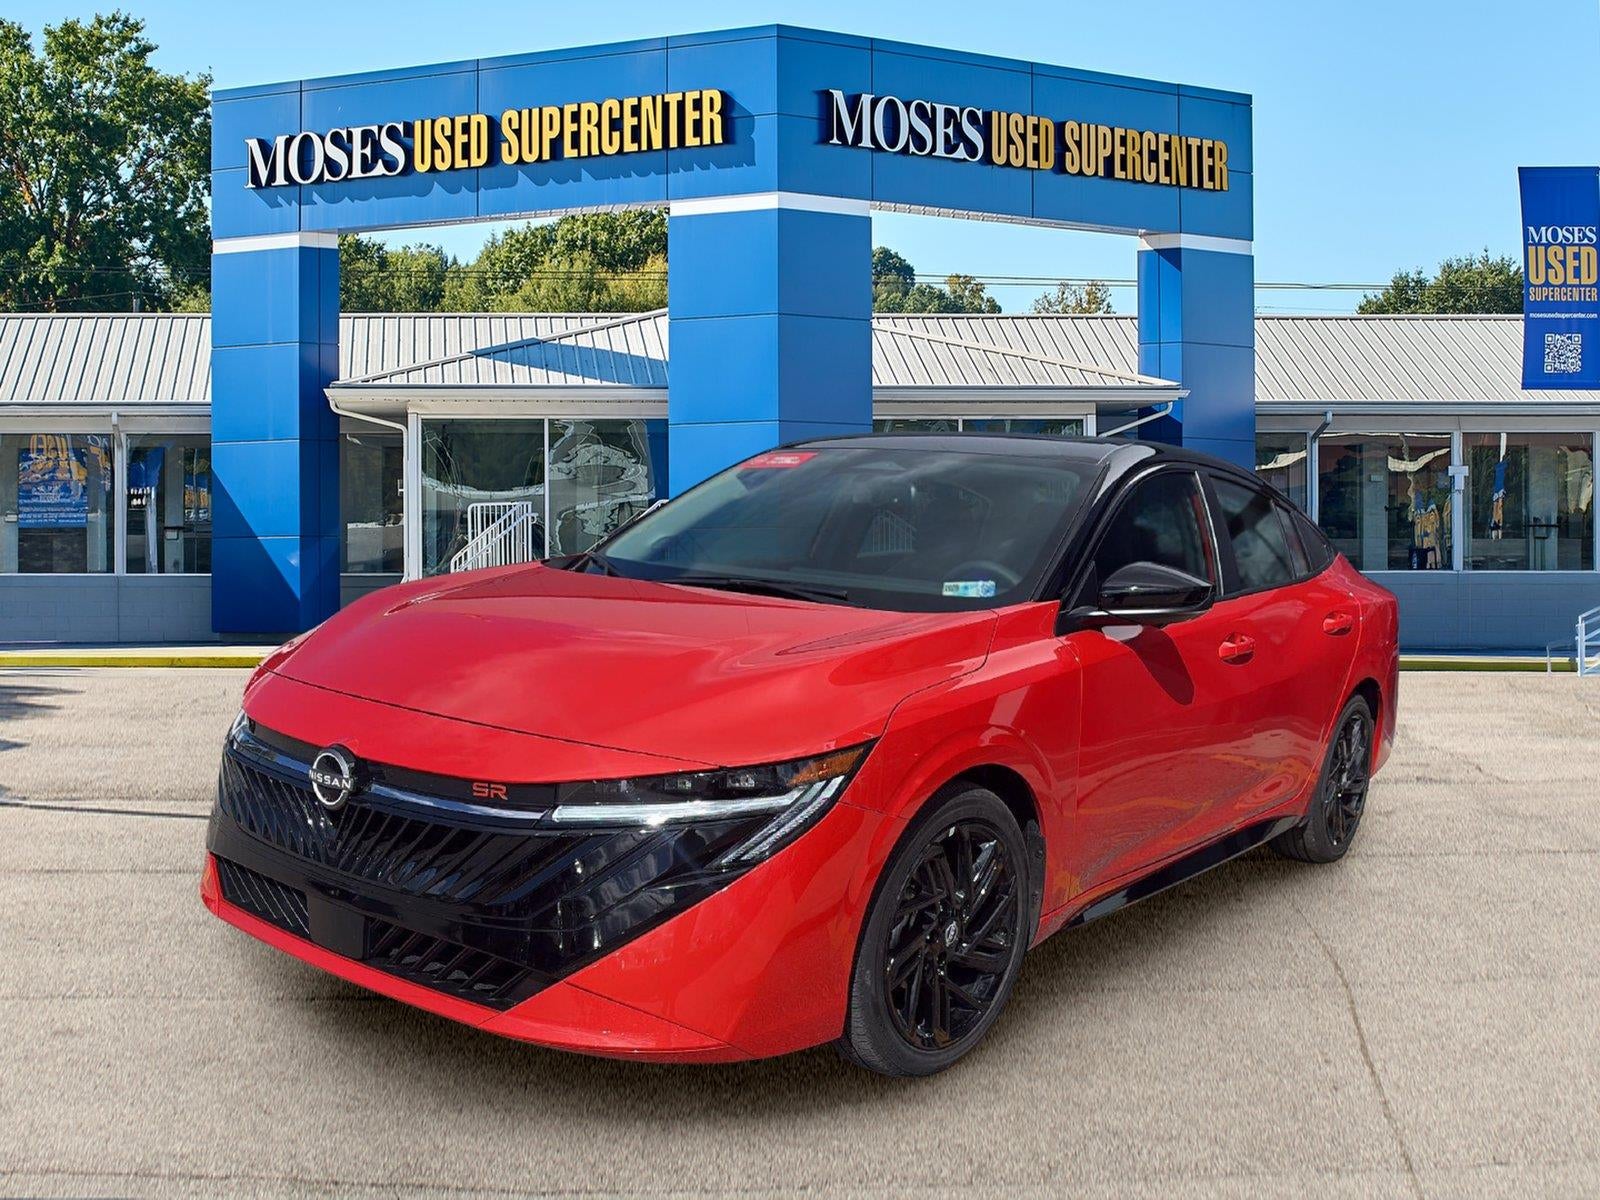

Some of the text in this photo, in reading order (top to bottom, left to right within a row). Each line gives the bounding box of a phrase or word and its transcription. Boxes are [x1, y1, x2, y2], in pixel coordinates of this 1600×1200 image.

[244, 88, 724, 190] MOSES USED SUPERCENTER
[829, 89, 1229, 192] MOSES USED SUPERCENTER
[1527, 226, 1597, 244] MOSES
[1528, 245, 1598, 286] USED
[1529, 287, 1598, 302] SUPERCENTER
[309, 769, 351, 789] NISSAN
[472, 781, 508, 800] SR
